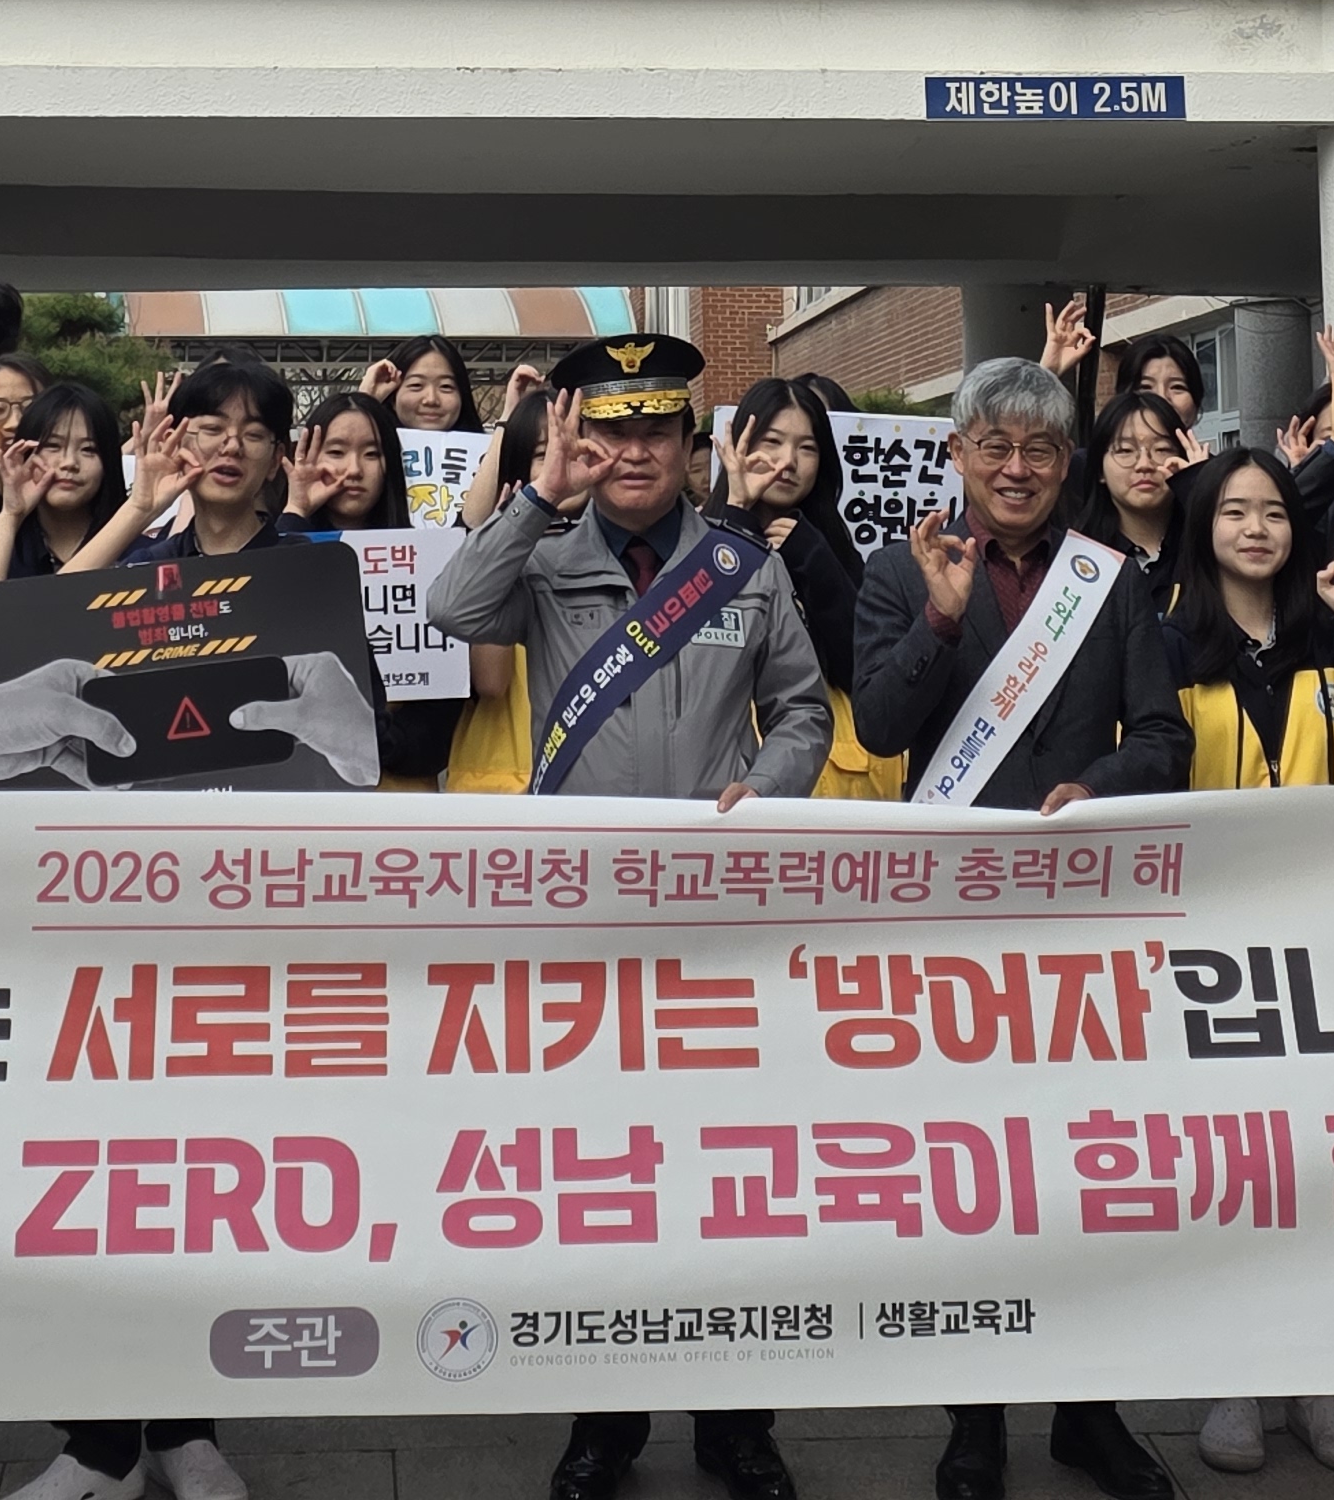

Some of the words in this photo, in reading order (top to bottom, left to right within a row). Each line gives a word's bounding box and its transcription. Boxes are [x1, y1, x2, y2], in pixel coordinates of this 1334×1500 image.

[946, 82, 1077, 115] 제한높이
[1093, 82, 1166, 113] 2.5M
[842, 435, 952, 488] 한순간
[363, 544, 417, 575] 도박
[364, 584, 417, 615] 니면
[645, 568, 713, 638] 딥페이크
[151, 643, 200, 661] CRIME
[367, 622, 455, 655] 습니다.
[625, 620, 661, 657] Out!
[36, 850, 180, 904] 2026
[200, 847, 589, 910] 성남교육지원청
[612, 848, 939, 908] 학교폭력예방
[954, 845, 1114, 903] 총력의
[1133, 842, 1184, 897] 해
[46, 962, 390, 1081] 서로를
[425, 958, 760, 1074] 지키는
[14, 1135, 399, 1263] ZERO,
[436, 1124, 664, 1250] 성남
[699, 1115, 1041, 1240] 교육이
[1068, 1108, 1297, 1232] 함께
[243, 1314, 342, 1369] 주관
[509, 1302, 834, 1348] 경기도성남교육지원청
[875, 1298, 1036, 1338] 생활교육과
[509, 1353, 598, 1366] GYEONGGIDO
[603, 1351, 677, 1365] SEONGNAM
[683, 1350, 730, 1363] OFFICE
[736, 1349, 753, 1362] OF
[760, 1347, 835, 1361] EDUCATION
